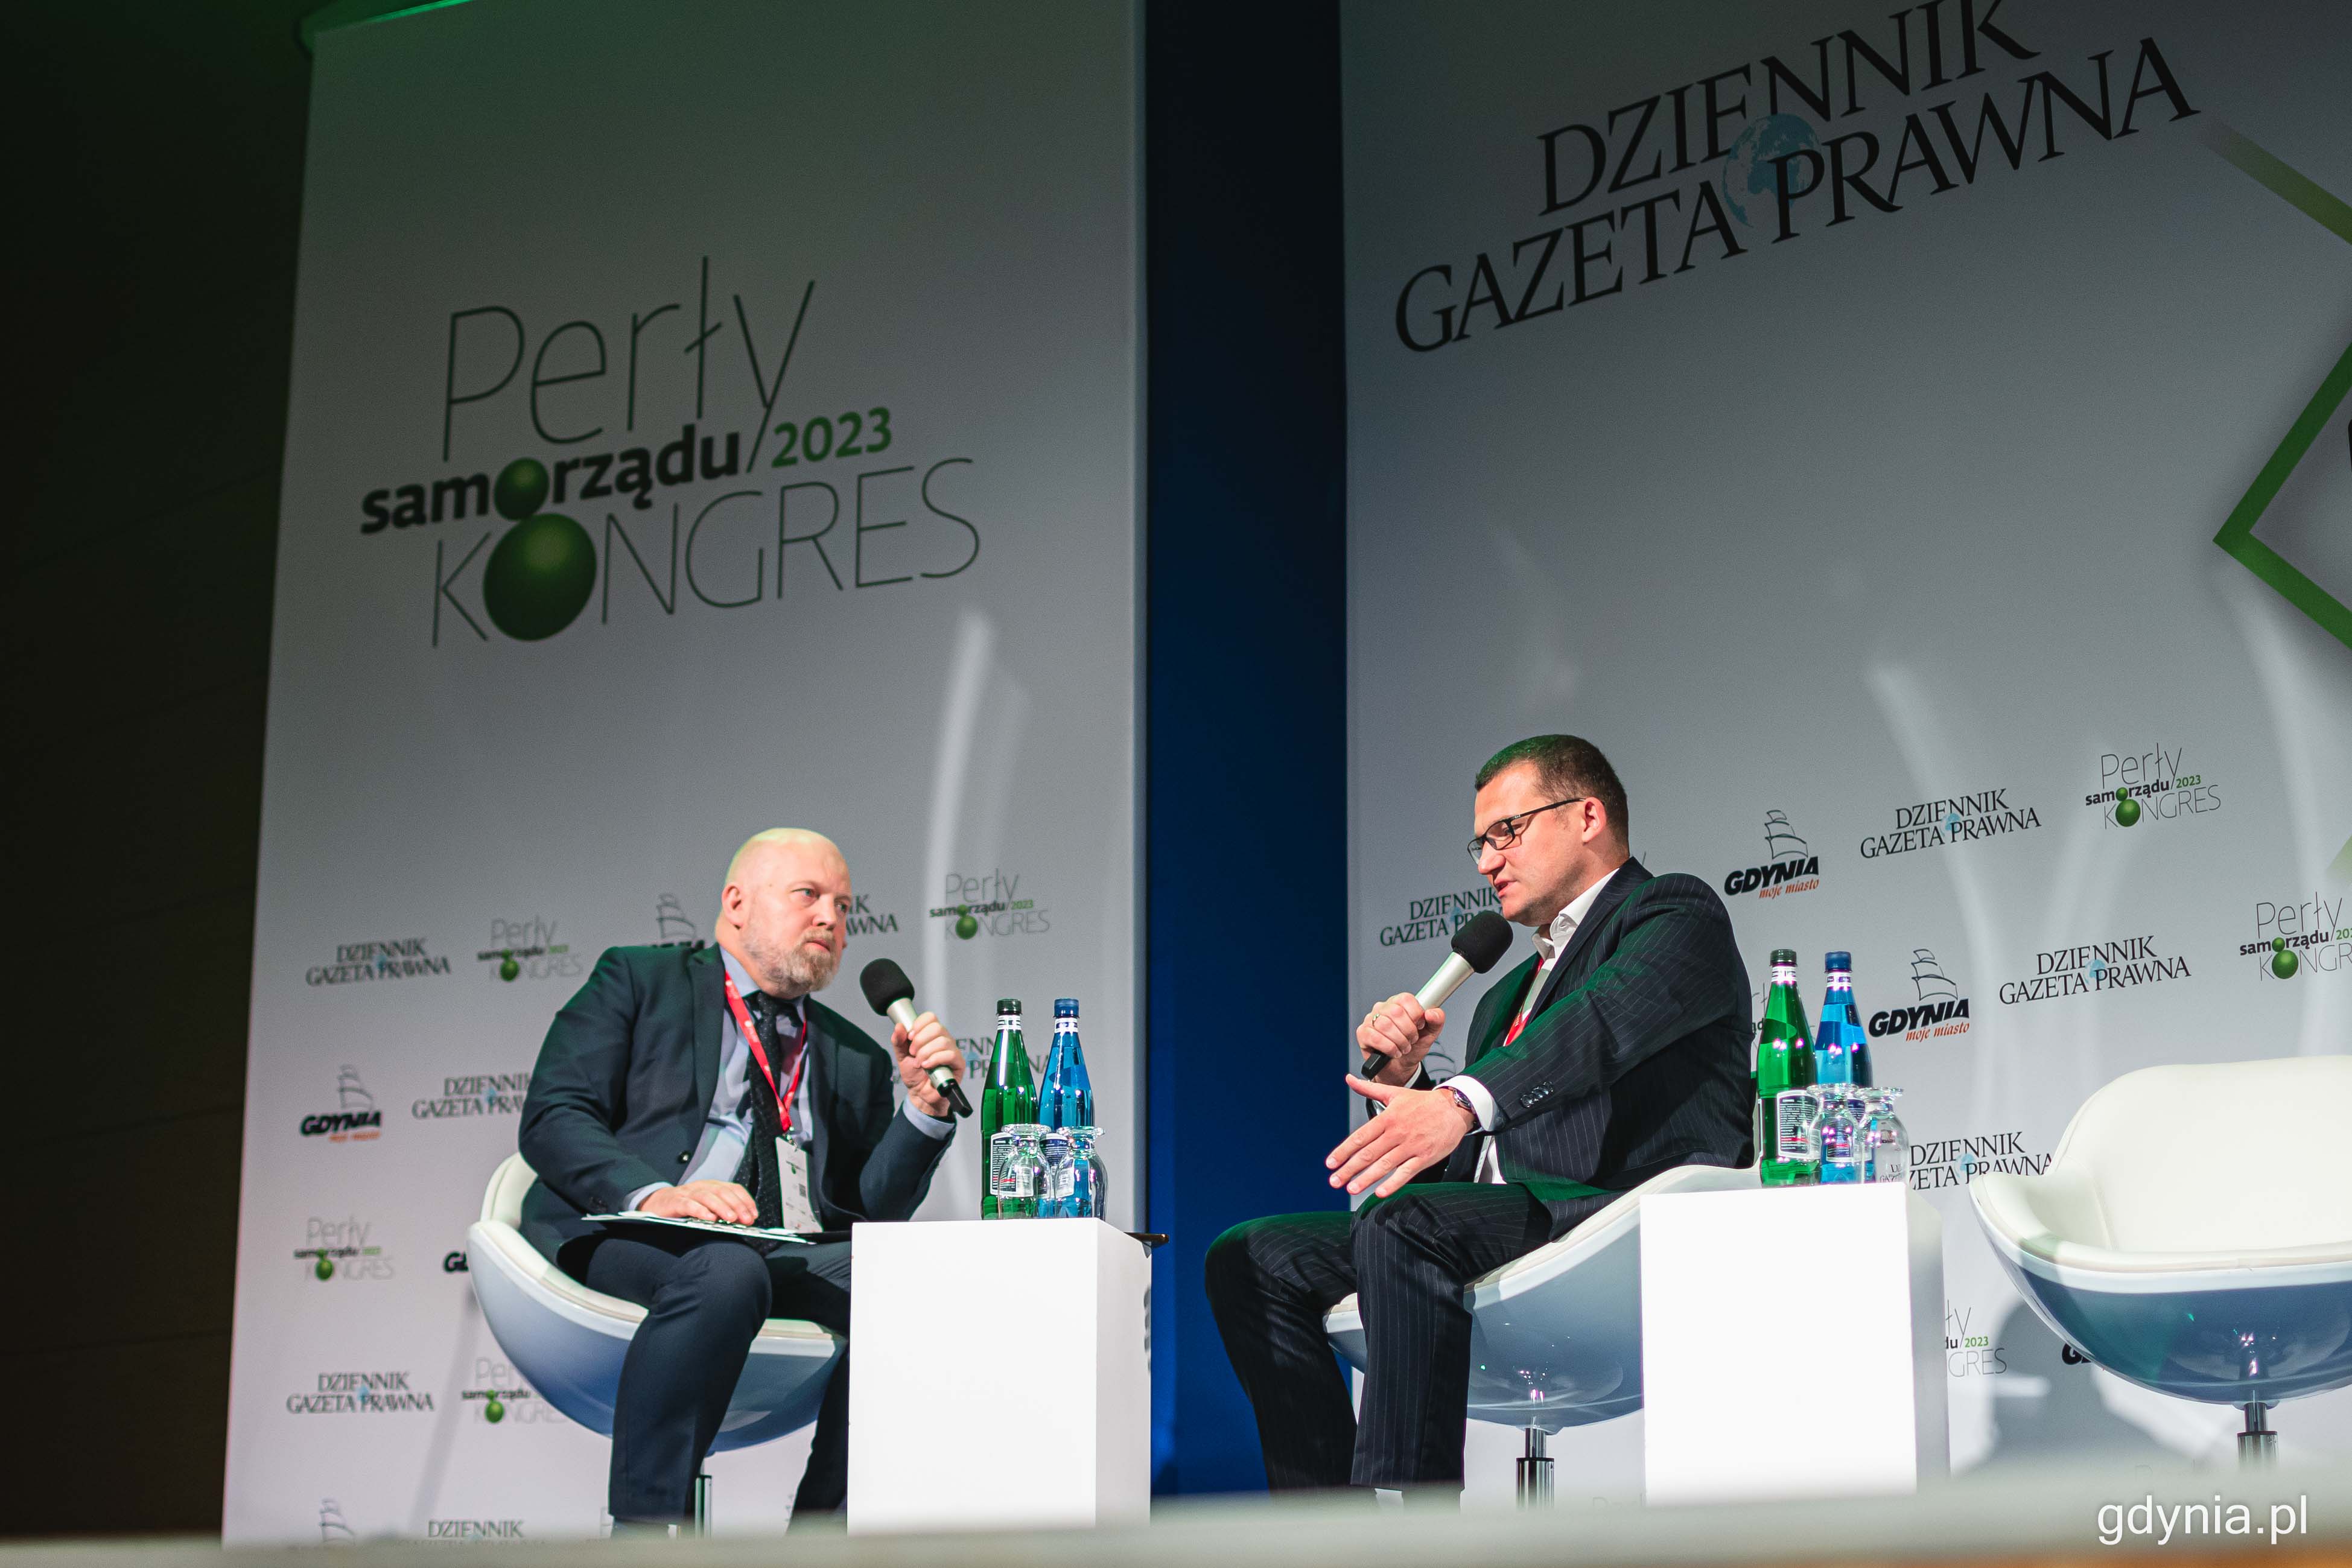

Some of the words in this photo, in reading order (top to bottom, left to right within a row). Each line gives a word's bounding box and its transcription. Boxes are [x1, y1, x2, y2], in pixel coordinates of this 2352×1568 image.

[1537, 0, 2041, 216] DZIENNIK
[1394, 180, 1748, 353] GAZETA
[1767, 37, 2201, 243] PRAWNA
[443, 256, 815, 472] Perły
[361, 424, 740, 534] samorządu
[771, 406, 892, 469] 2023
[433, 457, 980, 647] KONGRES
[2101, 743, 2182, 790] Perły
[2085, 779, 2170, 805] samorządu
[2175, 775, 2202, 789] 2023
[2103, 784, 2222, 830] KONGRES
[1895, 789, 2009, 830] DZIENNIK
[1860, 825, 1945, 859] GAZETA
[1949, 807, 2042, 843] PRAWNA
[945, 868, 1020, 911] Perły
[1724, 855, 1819, 897] GDYNIA
[1758, 884, 1783, 900] moje
[1785, 877, 1820, 894] miasto
[929, 900, 1006, 918] samorządu
[1010, 899, 1034, 910] 2023
[945, 910, 1051, 941] KONGRES
[2256, 891, 2343, 942] Perły
[336, 937, 426, 963] DZIENNIK
[1379, 918, 1449, 947] GAZETA
[2239, 930, 2330, 956] samorządu
[305, 963, 375, 987] GAZETA
[377, 956, 451, 980] PRAWNA
[2036, 935, 2158, 975] DZIENNIK
[1999, 973, 2090, 1006] GAZETA
[2093, 955, 2192, 992] PRAWNA
[1868, 998, 1970, 1038] GDYNIA
[1905, 1026, 1931, 1043] moje
[1933, 1021, 1970, 1037] miasto
[300, 1110, 382, 1137] GDYNIA
[412, 1097, 483, 1120] GAZETA
[1910, 1131, 2026, 1167] DZIENNIK
[1964, 1336, 1989, 1348] 2023
[318, 1371, 410, 1392] DZIENNIK
[286, 1393, 357, 1414] GAZETA
[360, 1391, 436, 1413] PRAWNA
[428, 1518, 524, 1538] DZIENNIK
